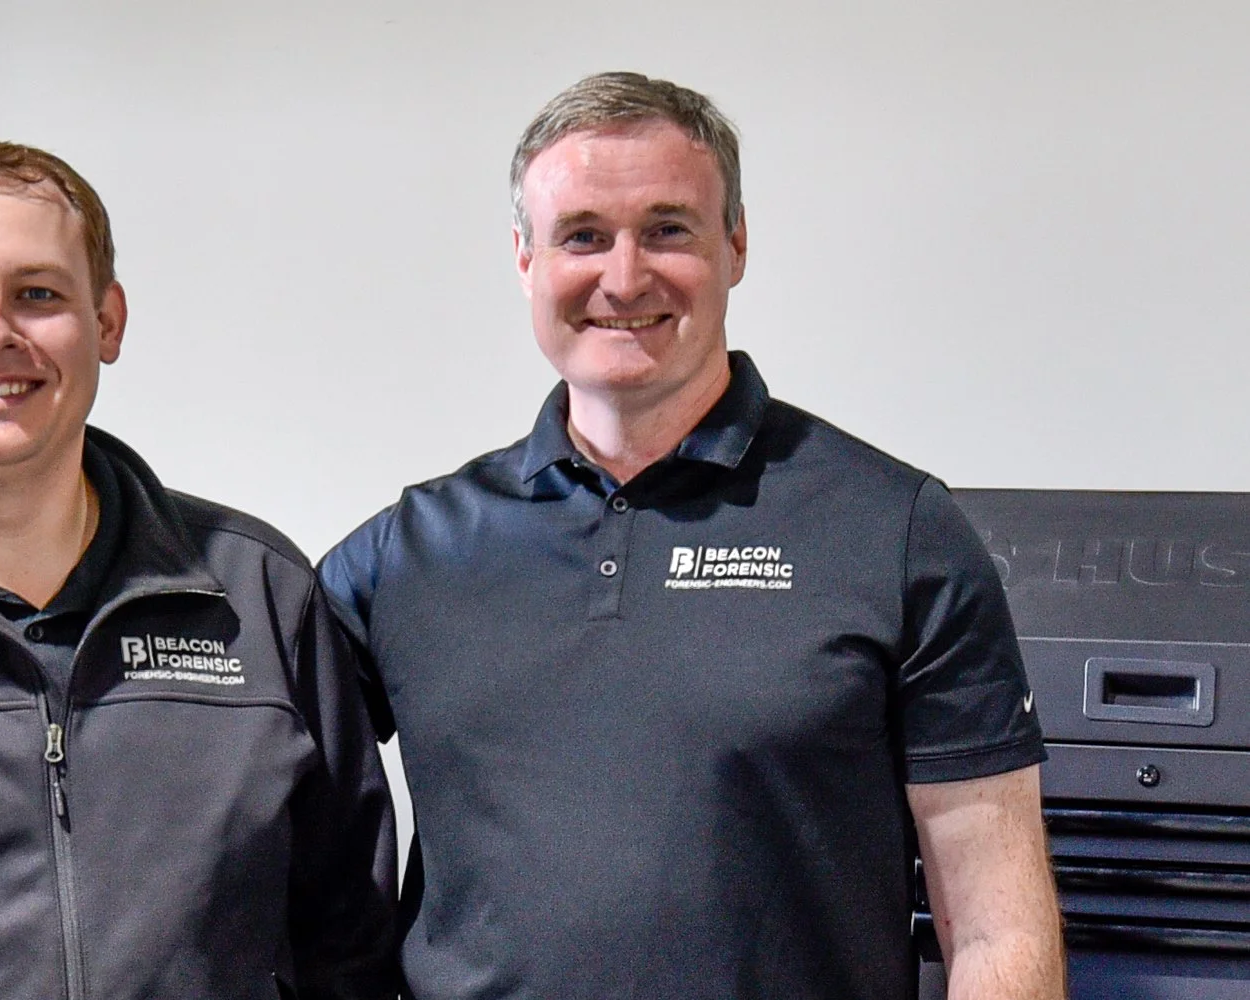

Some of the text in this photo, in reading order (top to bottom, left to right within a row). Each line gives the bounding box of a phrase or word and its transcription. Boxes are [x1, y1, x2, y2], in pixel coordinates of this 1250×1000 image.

[705, 547, 781, 561] BEACON
[702, 563, 793, 578] FORENSIC
[665, 579, 792, 590] FORENSIC-ENGINEERS.COM
[155, 637, 225, 654] BEACON
[158, 654, 242, 672] FORENSIC
